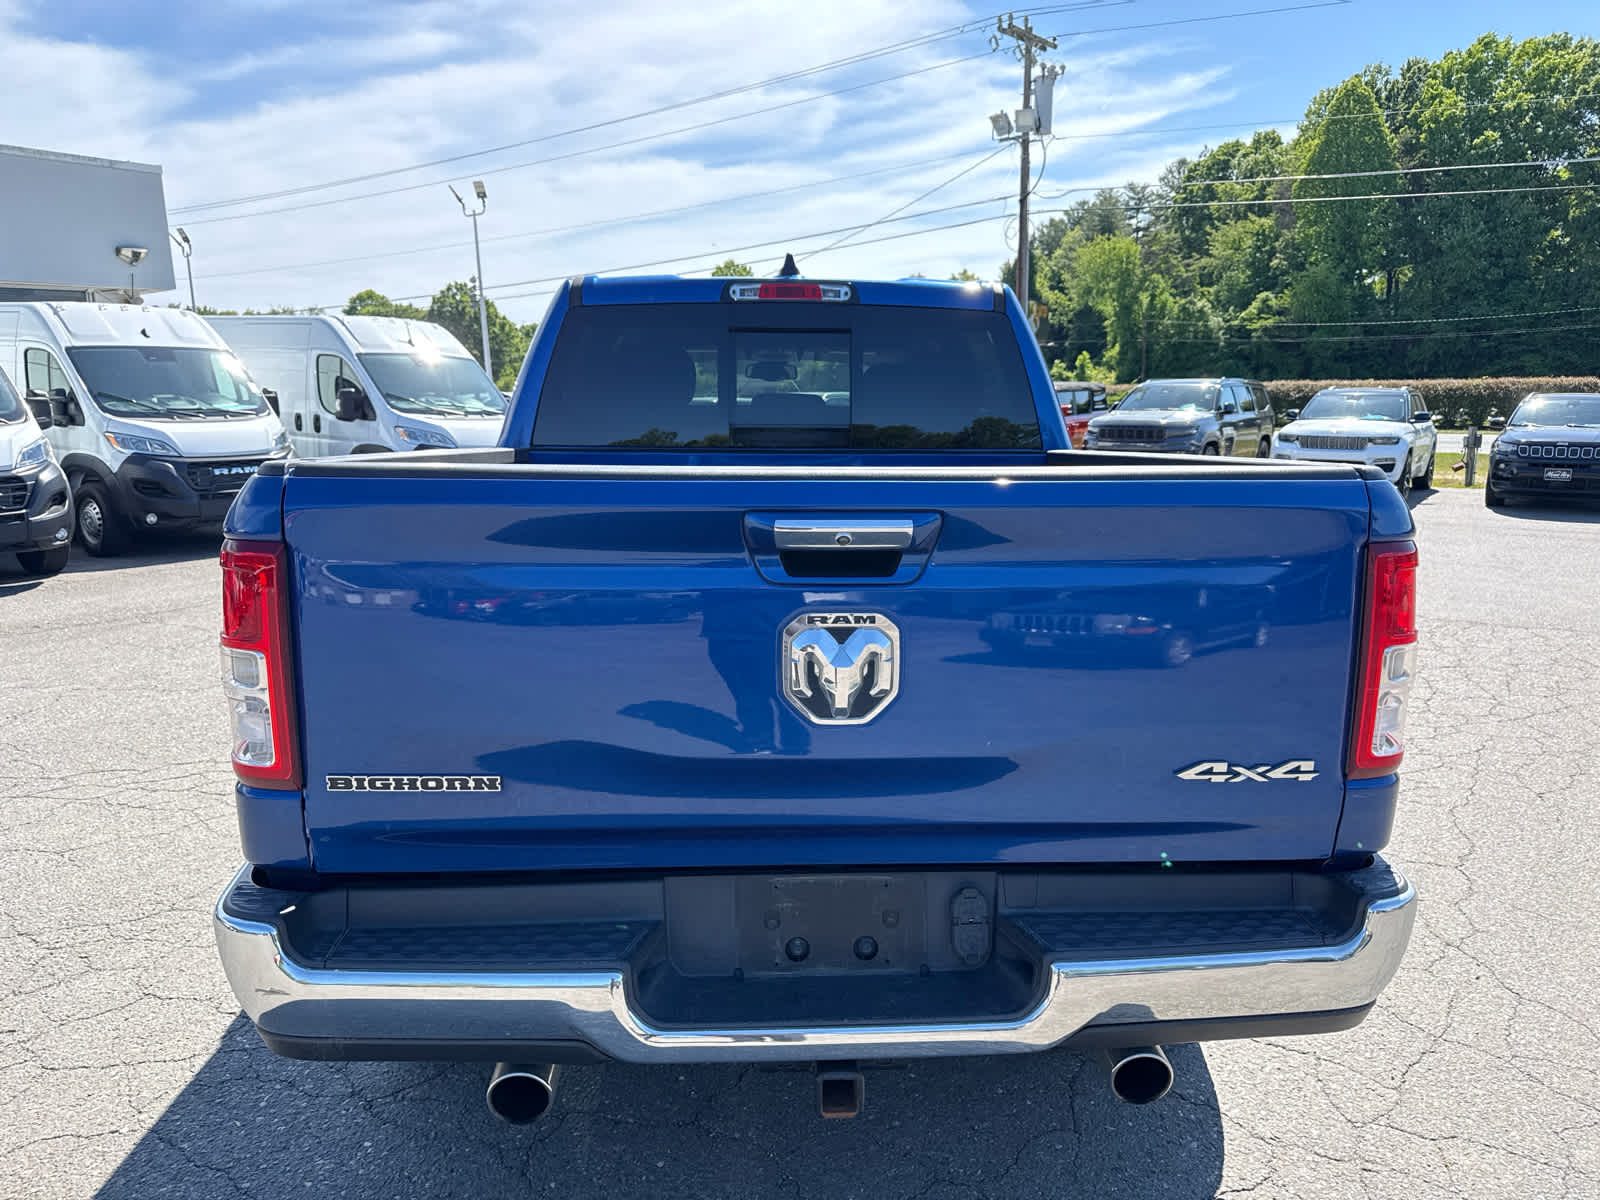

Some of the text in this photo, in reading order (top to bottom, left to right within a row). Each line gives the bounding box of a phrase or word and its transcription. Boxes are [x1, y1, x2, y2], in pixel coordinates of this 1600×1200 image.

[213, 466, 259, 475] RAM
[806, 615, 876, 625] RAM
[1176, 760, 1320, 783] 4x4
[325, 775, 502, 792] BIGHORN
